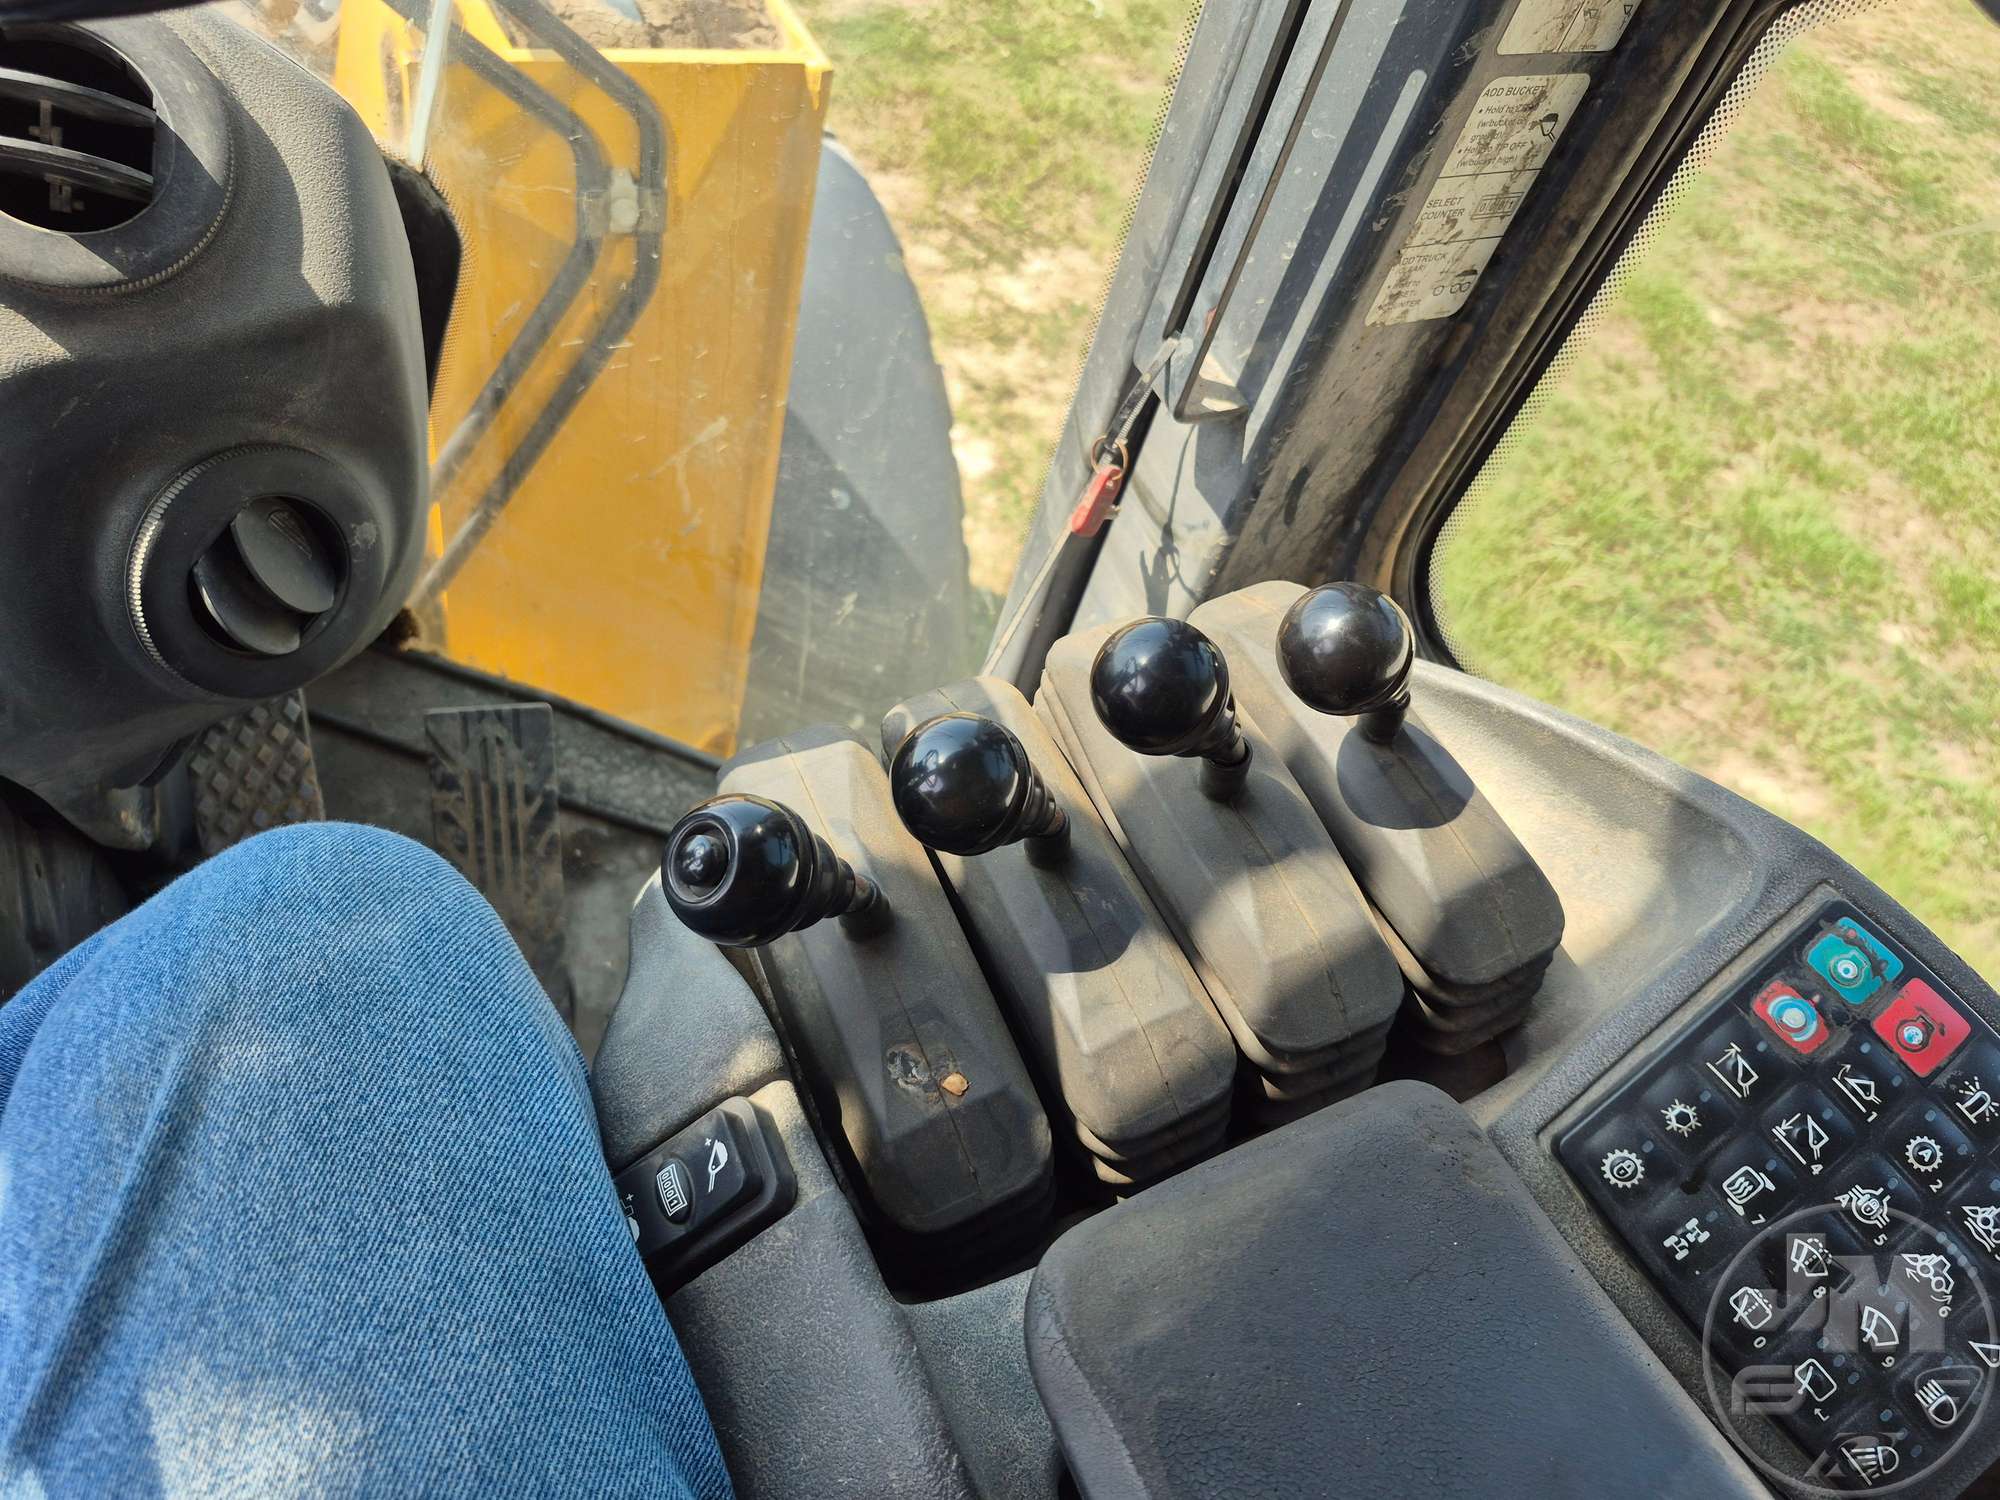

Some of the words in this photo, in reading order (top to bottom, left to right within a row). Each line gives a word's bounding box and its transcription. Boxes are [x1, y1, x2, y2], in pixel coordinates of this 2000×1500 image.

[1483, 88, 1504, 97] ADD
[1506, 85, 1547, 97] BUCKET
[1427, 197, 1464, 208] SELECT
[1420, 208, 1465, 221] COUNTER
[1415, 253, 1448, 264] TRUCK
[1866, 1111, 1878, 1123] 1
[1810, 1162, 1824, 1175] 4
[1929, 1178, 1943, 1193] 2
[1751, 1214, 1767, 1226] 7
[1873, 1233, 1888, 1247] 5
[1813, 1285, 1827, 1299] 8
[1938, 1305, 1952, 1319] 6
[1882, 1355, 1895, 1368] 9
